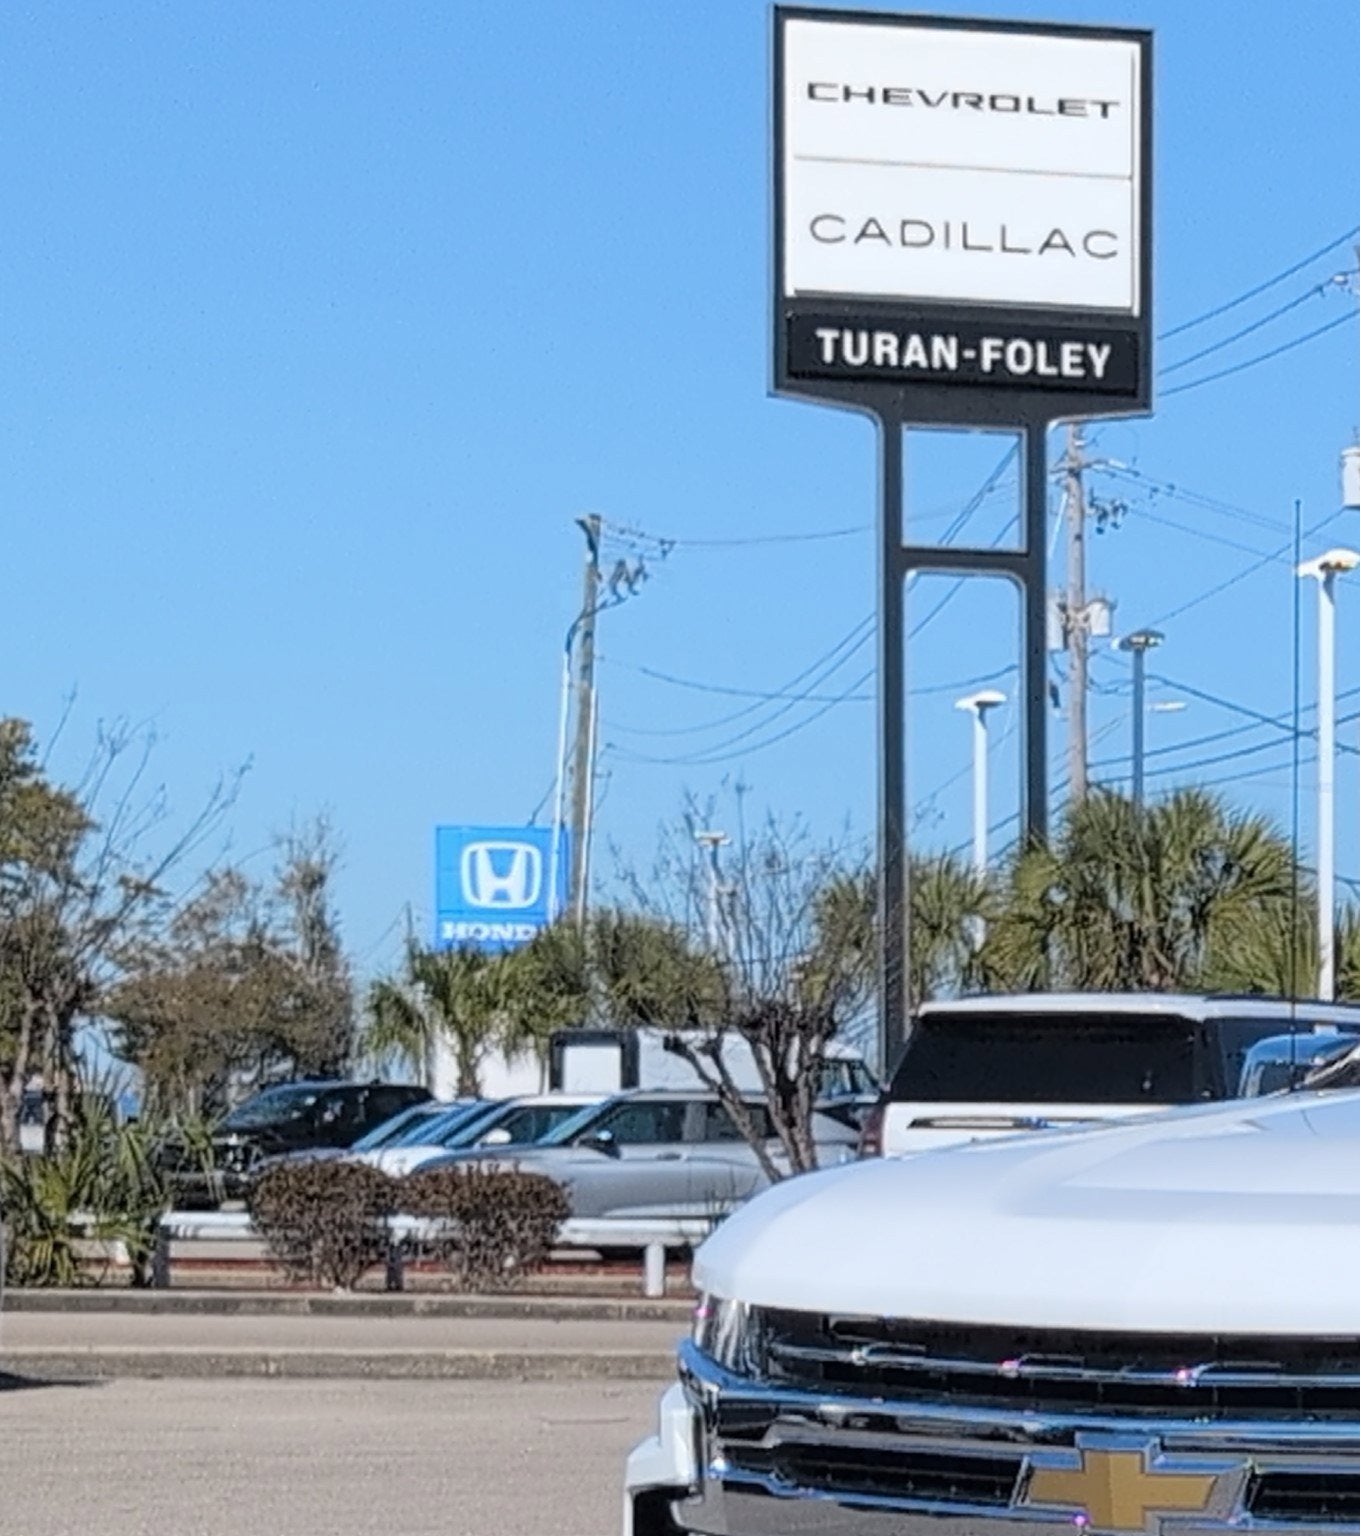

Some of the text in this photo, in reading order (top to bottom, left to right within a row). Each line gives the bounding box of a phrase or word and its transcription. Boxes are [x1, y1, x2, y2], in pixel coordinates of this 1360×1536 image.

[806, 82, 1120, 119] CHEVROLET
[809, 214, 1119, 260] CADILLAC
[816, 329, 1111, 379] TURAN-FOLEY
[443, 921, 543, 940] HOND
